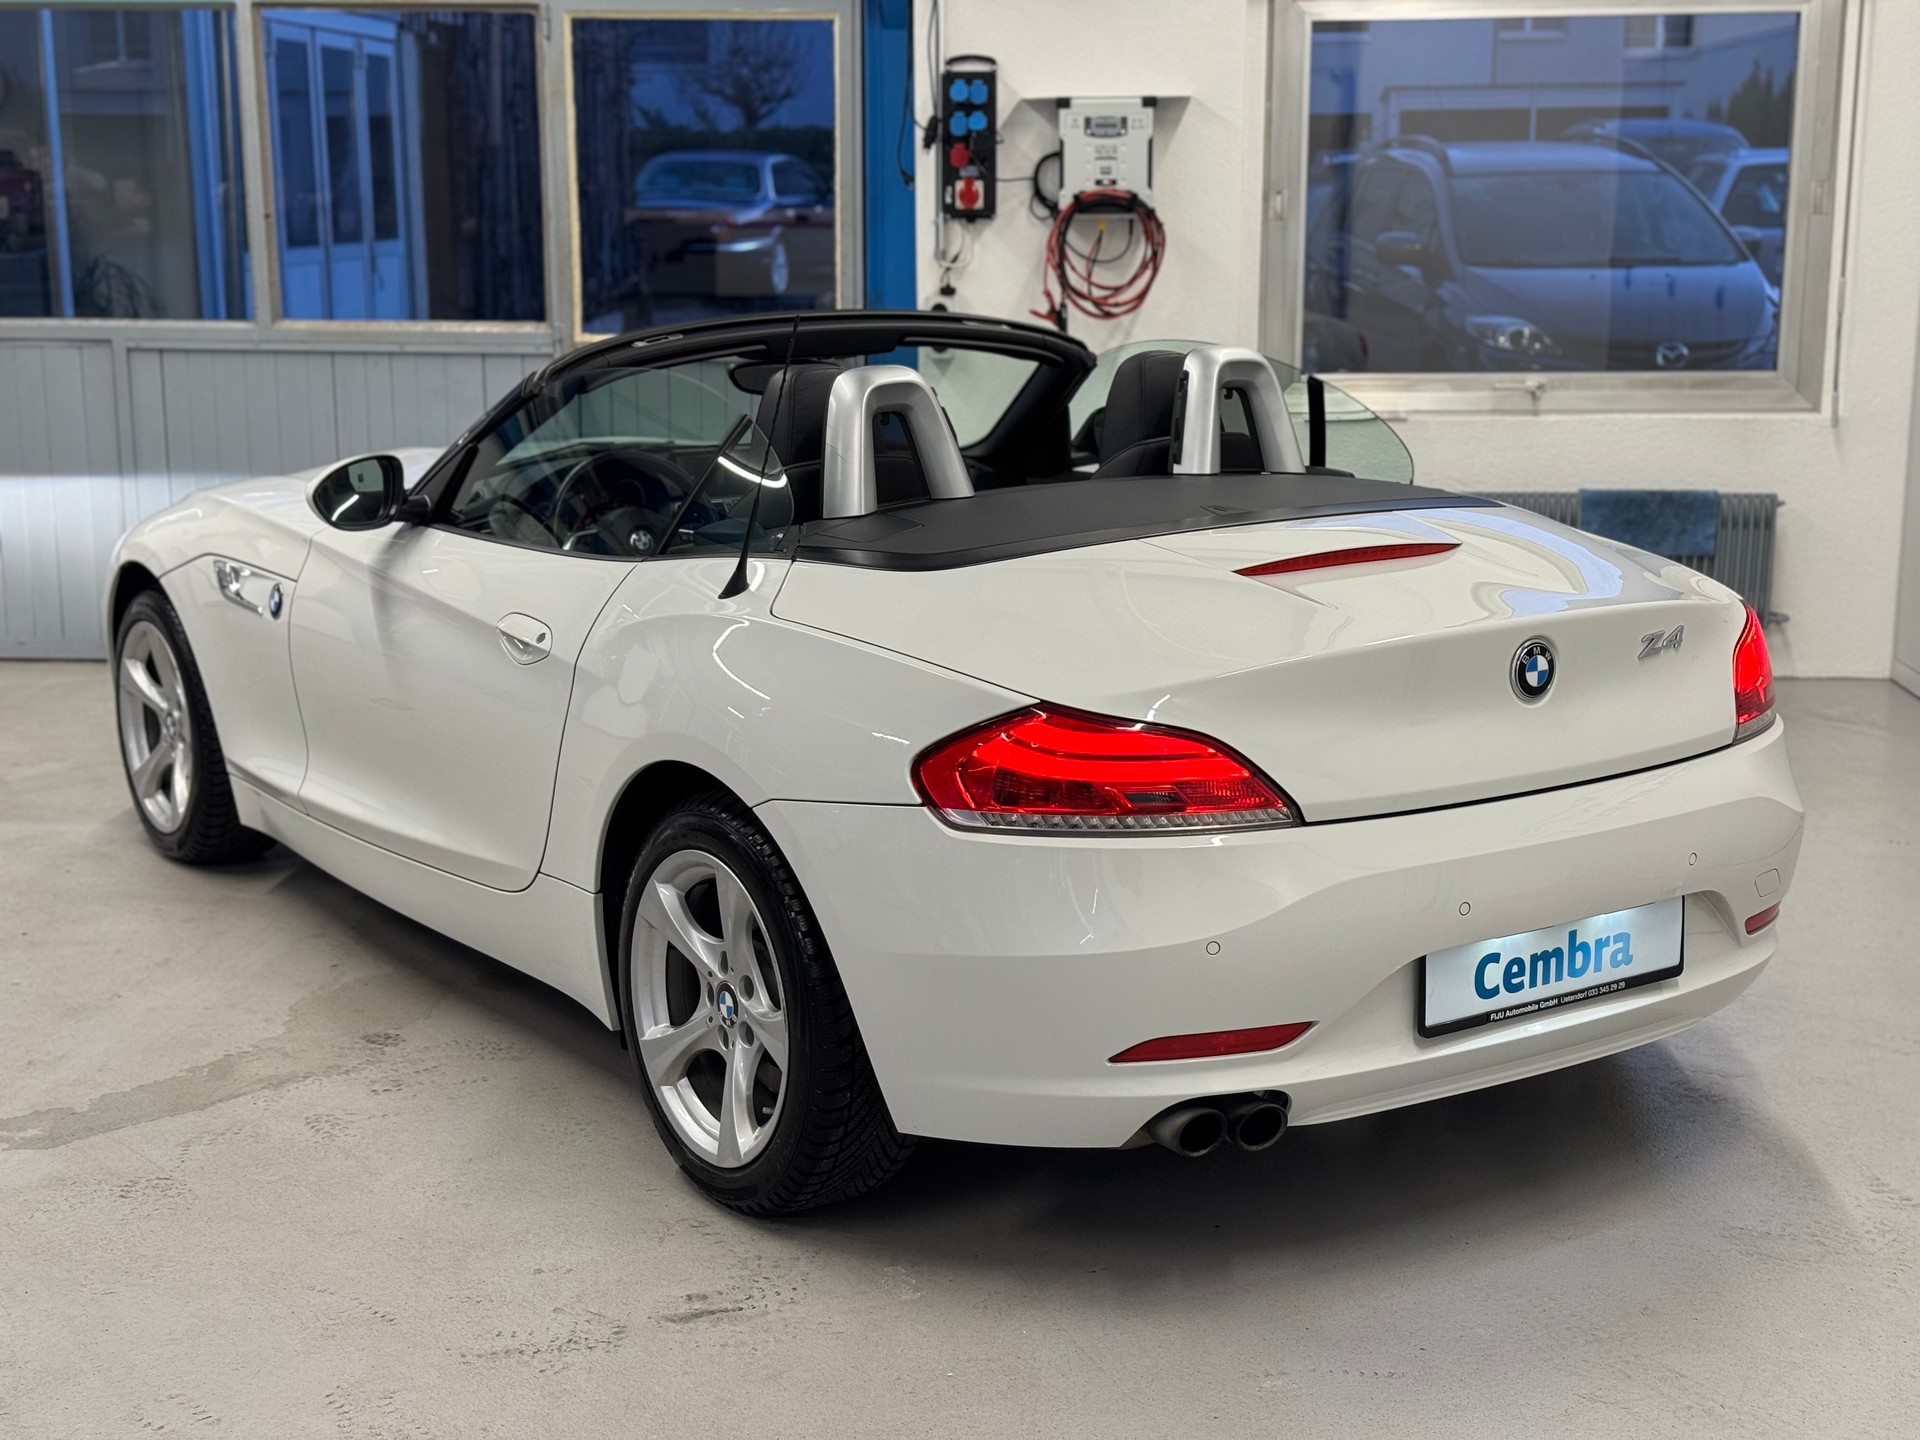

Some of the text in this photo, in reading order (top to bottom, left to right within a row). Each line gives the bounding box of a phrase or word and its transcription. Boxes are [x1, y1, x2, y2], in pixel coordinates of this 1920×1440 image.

[1521, 646, 1552, 665] BMW
[1638, 624, 1684, 660] Z4
[1474, 929, 1634, 1000] Cembra
[1490, 981, 1626, 1021] FIJU Automobile GmbH Uetendorf 033 345 29 29
